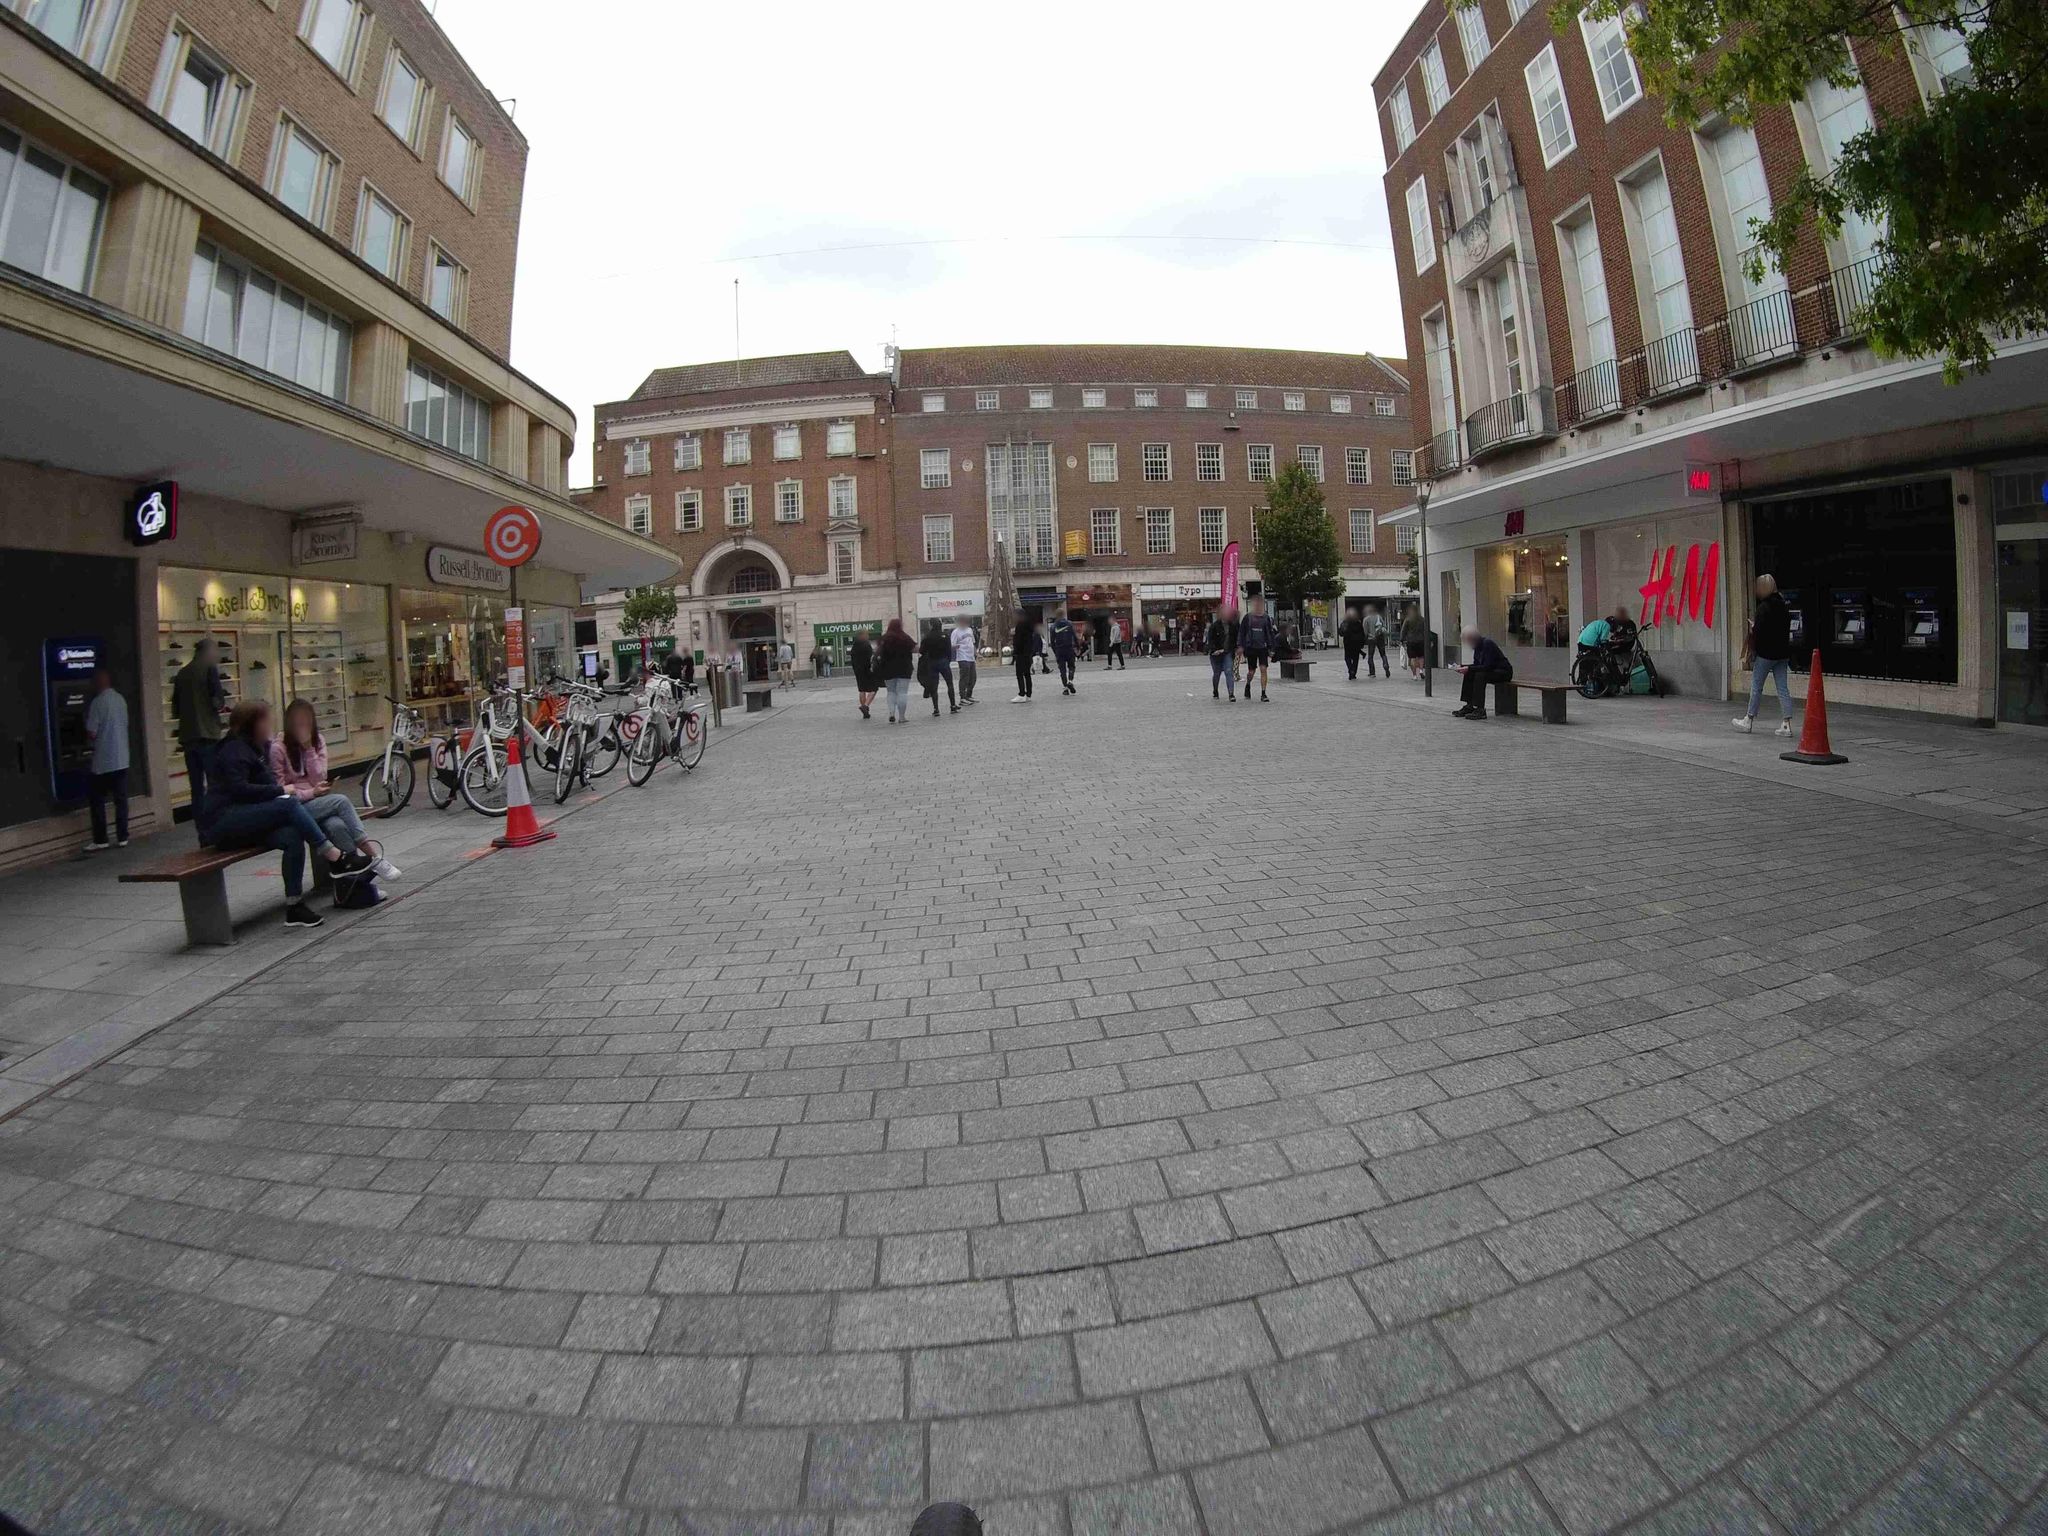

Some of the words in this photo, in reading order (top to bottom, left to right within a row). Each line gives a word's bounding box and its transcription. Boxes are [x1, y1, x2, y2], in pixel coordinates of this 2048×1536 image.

[1639, 540, 1720, 629] H&M
[1179, 585, 1201, 596] Typo
[820, 624, 851, 634] LLOYDS
[852, 623, 874, 632] BANK
[619, 642, 642, 651] LLOYD
